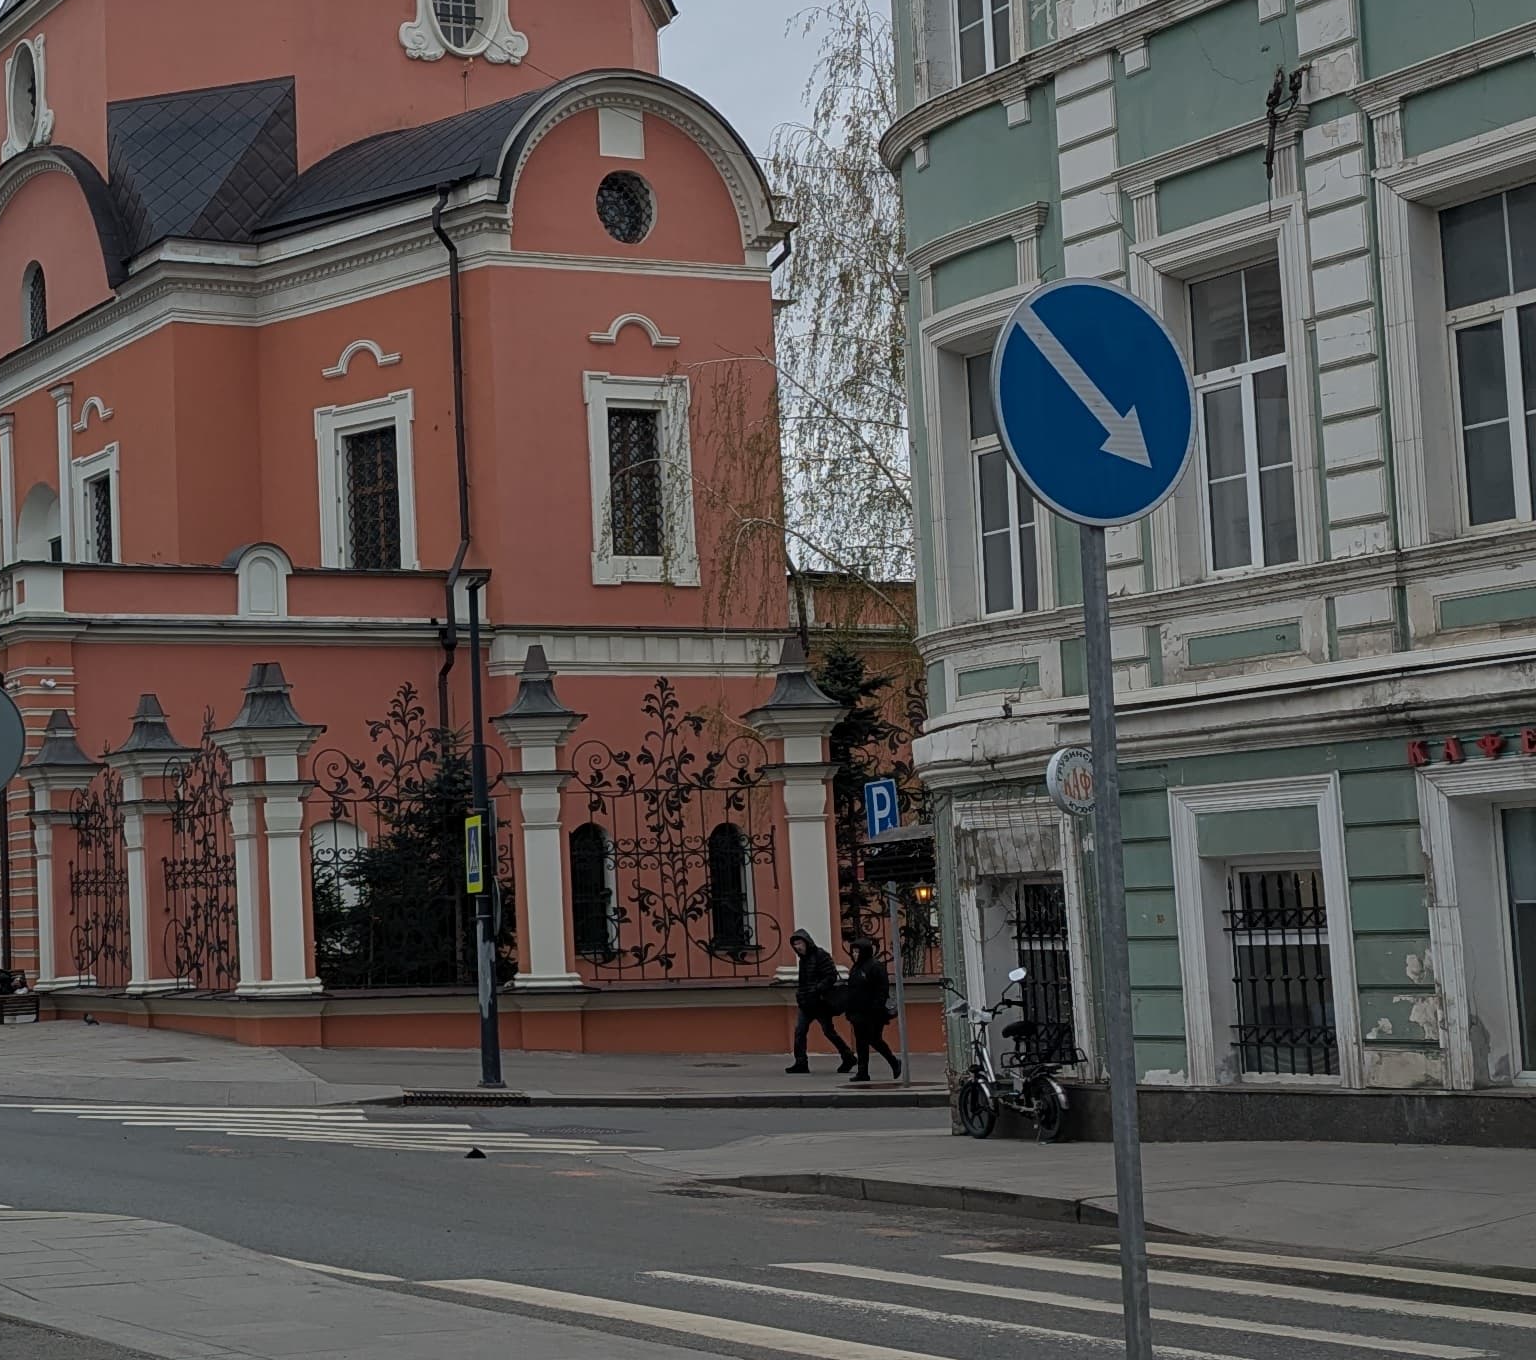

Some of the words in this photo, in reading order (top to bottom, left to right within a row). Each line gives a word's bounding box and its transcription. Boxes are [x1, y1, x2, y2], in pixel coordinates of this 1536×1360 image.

[1406, 727, 1536, 765] КАФЕ
[1063, 767, 1091, 801] КАФ
[871, 785, 892, 836] P
